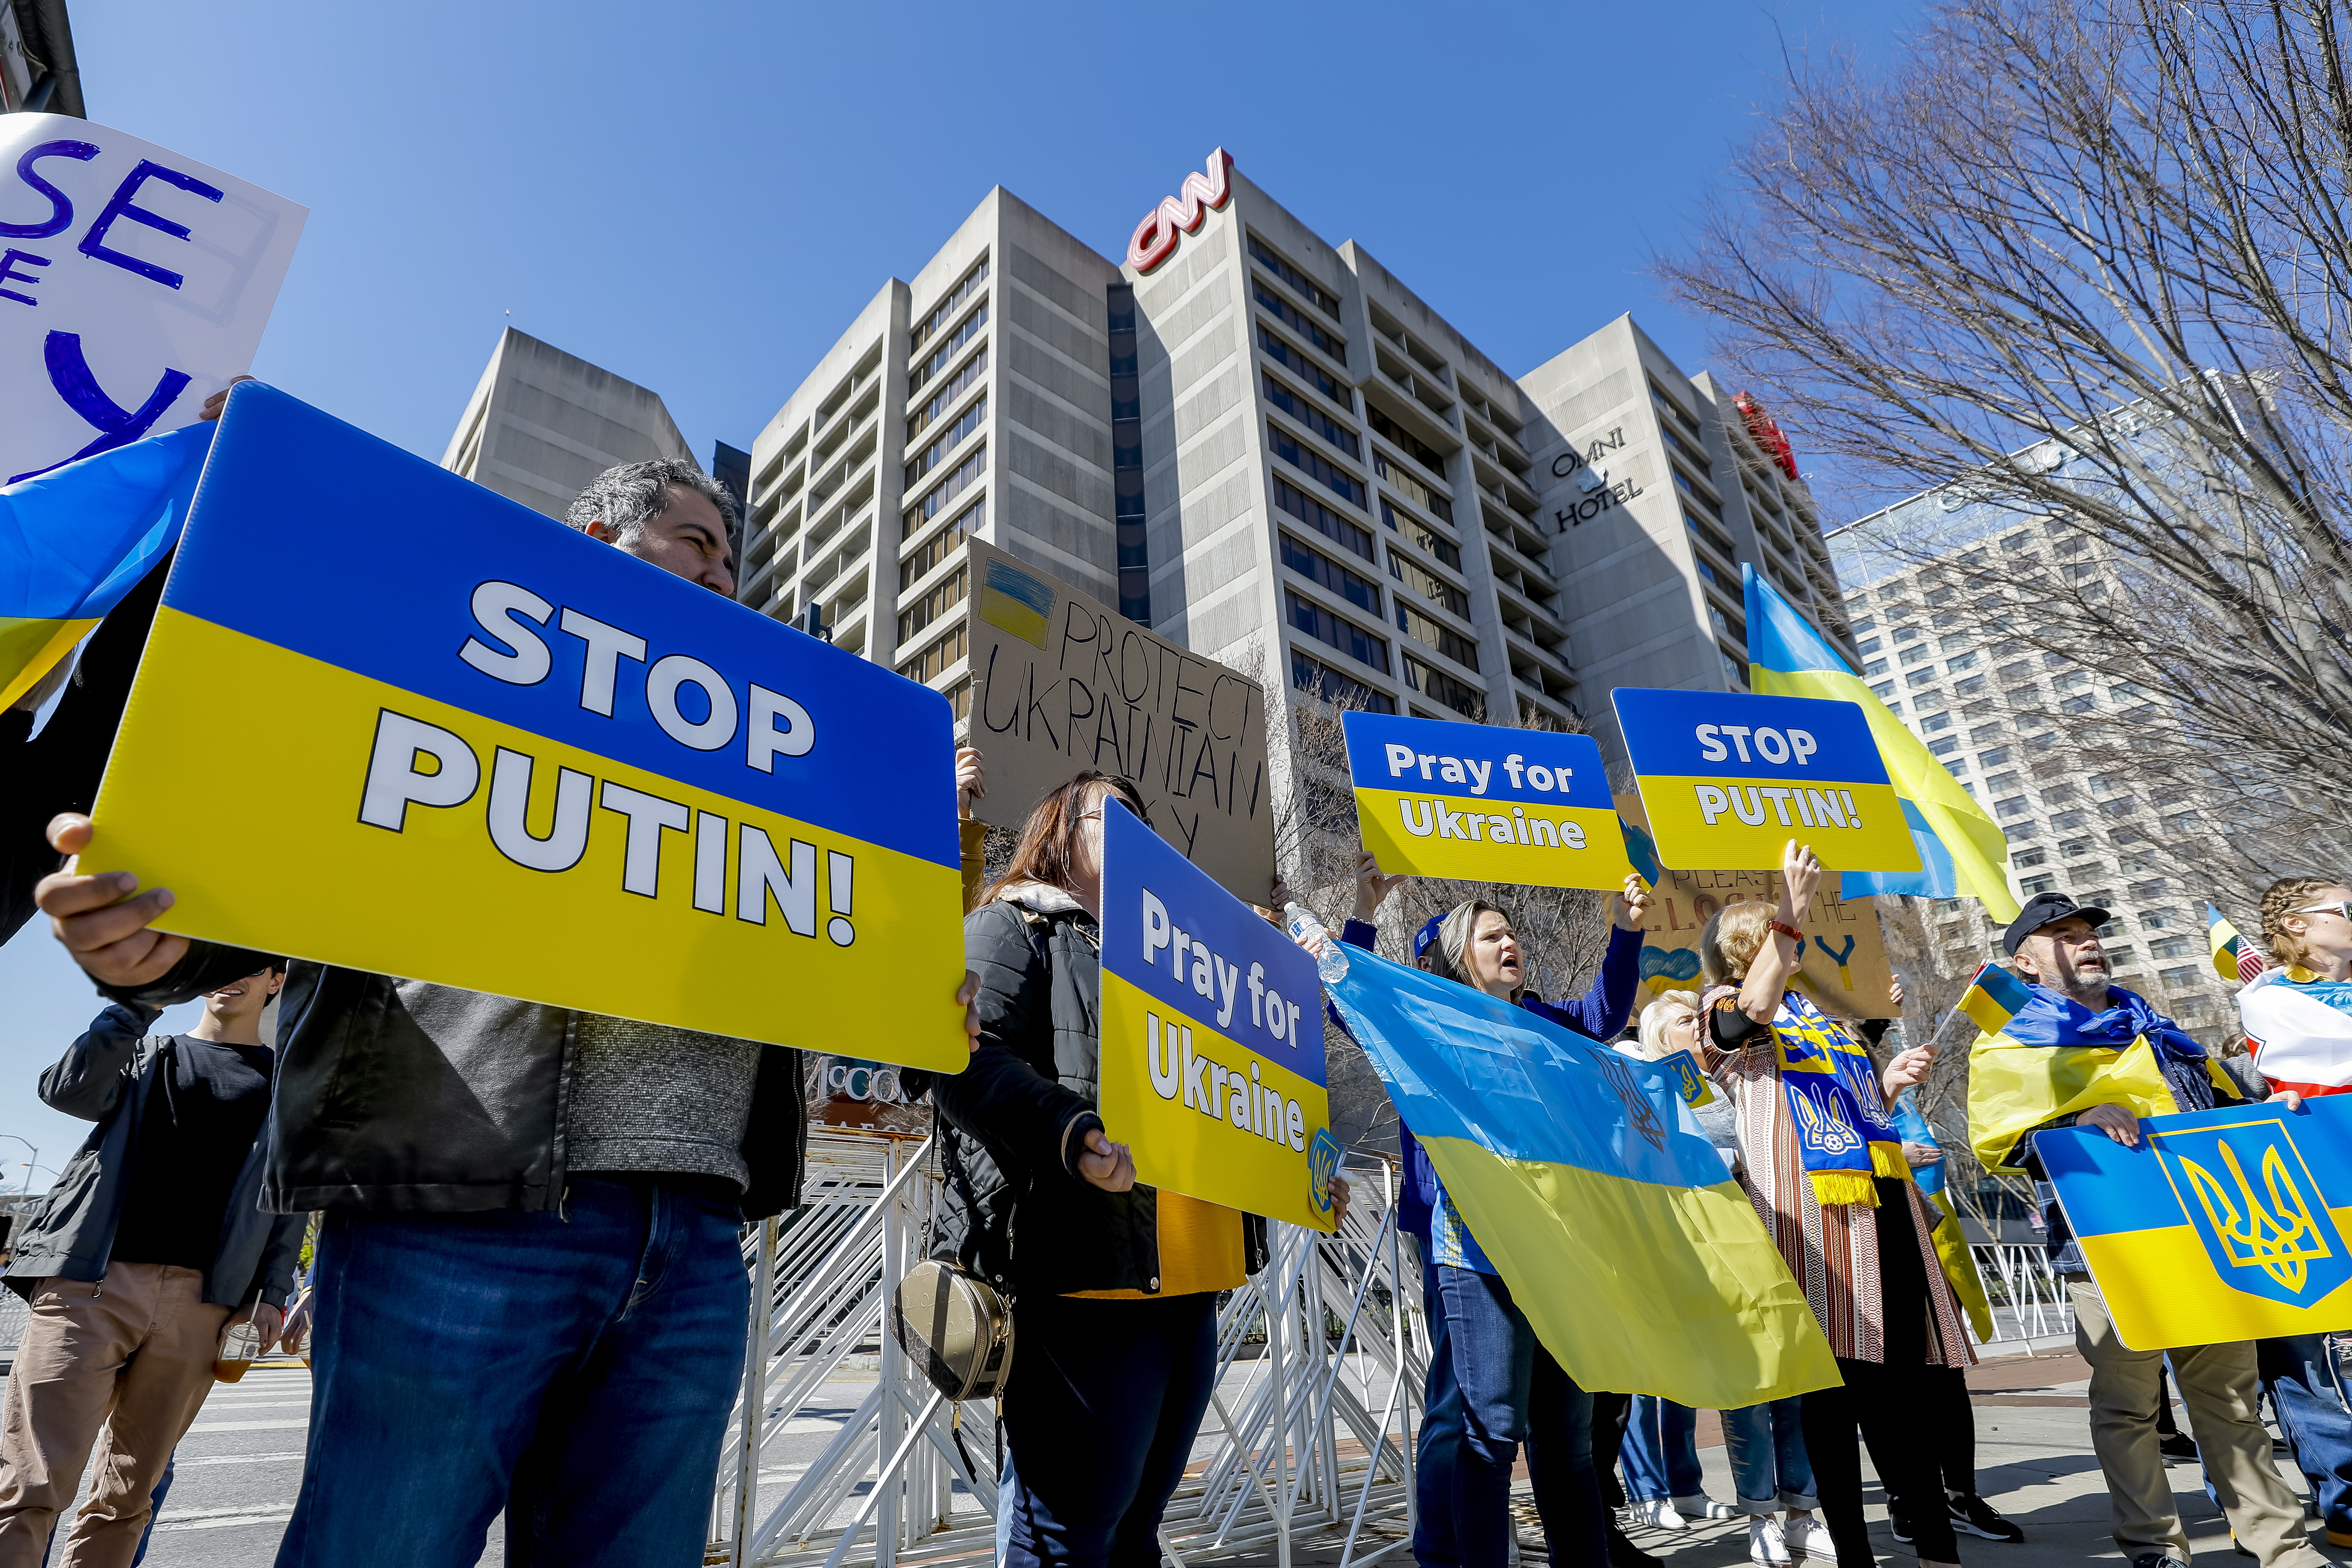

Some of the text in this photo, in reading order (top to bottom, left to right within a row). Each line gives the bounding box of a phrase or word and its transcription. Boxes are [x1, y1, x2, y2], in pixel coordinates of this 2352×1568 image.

[0, 139, 225, 291] SE
[1126, 145, 1234, 272] CNN
[1552, 425, 1627, 477] OMNI
[1554, 476, 1645, 533] HOTEL
[457, 579, 816, 776] STOP
[982, 643, 1262, 821] UKRAINIAN
[1060, 600, 1264, 748] PROTECT
[1384, 742, 1574, 796] Pray for
[1693, 784, 1863, 830] PUTIN!
[1694, 722, 1819, 766] STOP
[359, 708, 856, 948] PUTIN!
[1398, 798, 1588, 850] Ukraine
[1141, 886, 1301, 1049] Pray for
[1147, 1011, 1306, 1153] Ukraine
